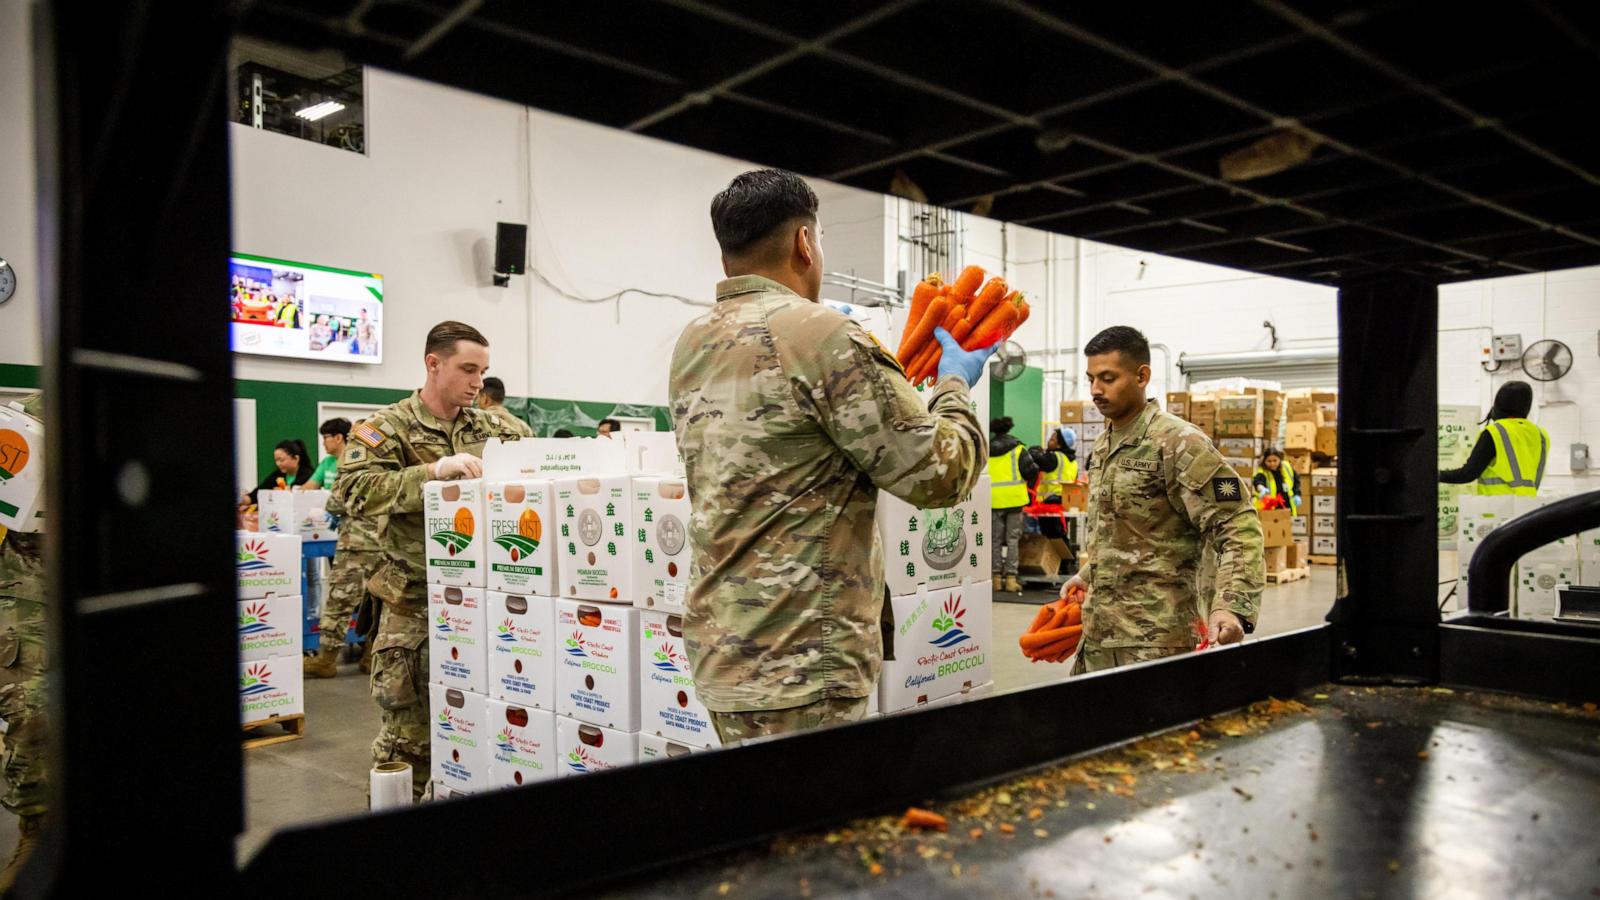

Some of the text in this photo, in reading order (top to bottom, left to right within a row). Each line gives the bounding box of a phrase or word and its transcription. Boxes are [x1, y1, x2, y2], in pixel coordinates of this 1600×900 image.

[1133, 461, 1153, 470] ARMY
[514, 566, 536, 574] BROCCOLI
[512, 646, 543, 657] BROCCOLI
[582, 660, 617, 674] BROCCOLI
[904, 653, 985, 689] California BROCCOLI
[594, 699, 610, 708] PRODUCE
[659, 710, 707, 729] PACIFIC COAST PRODUCE
[511, 755, 543, 770] BROCCOLI
